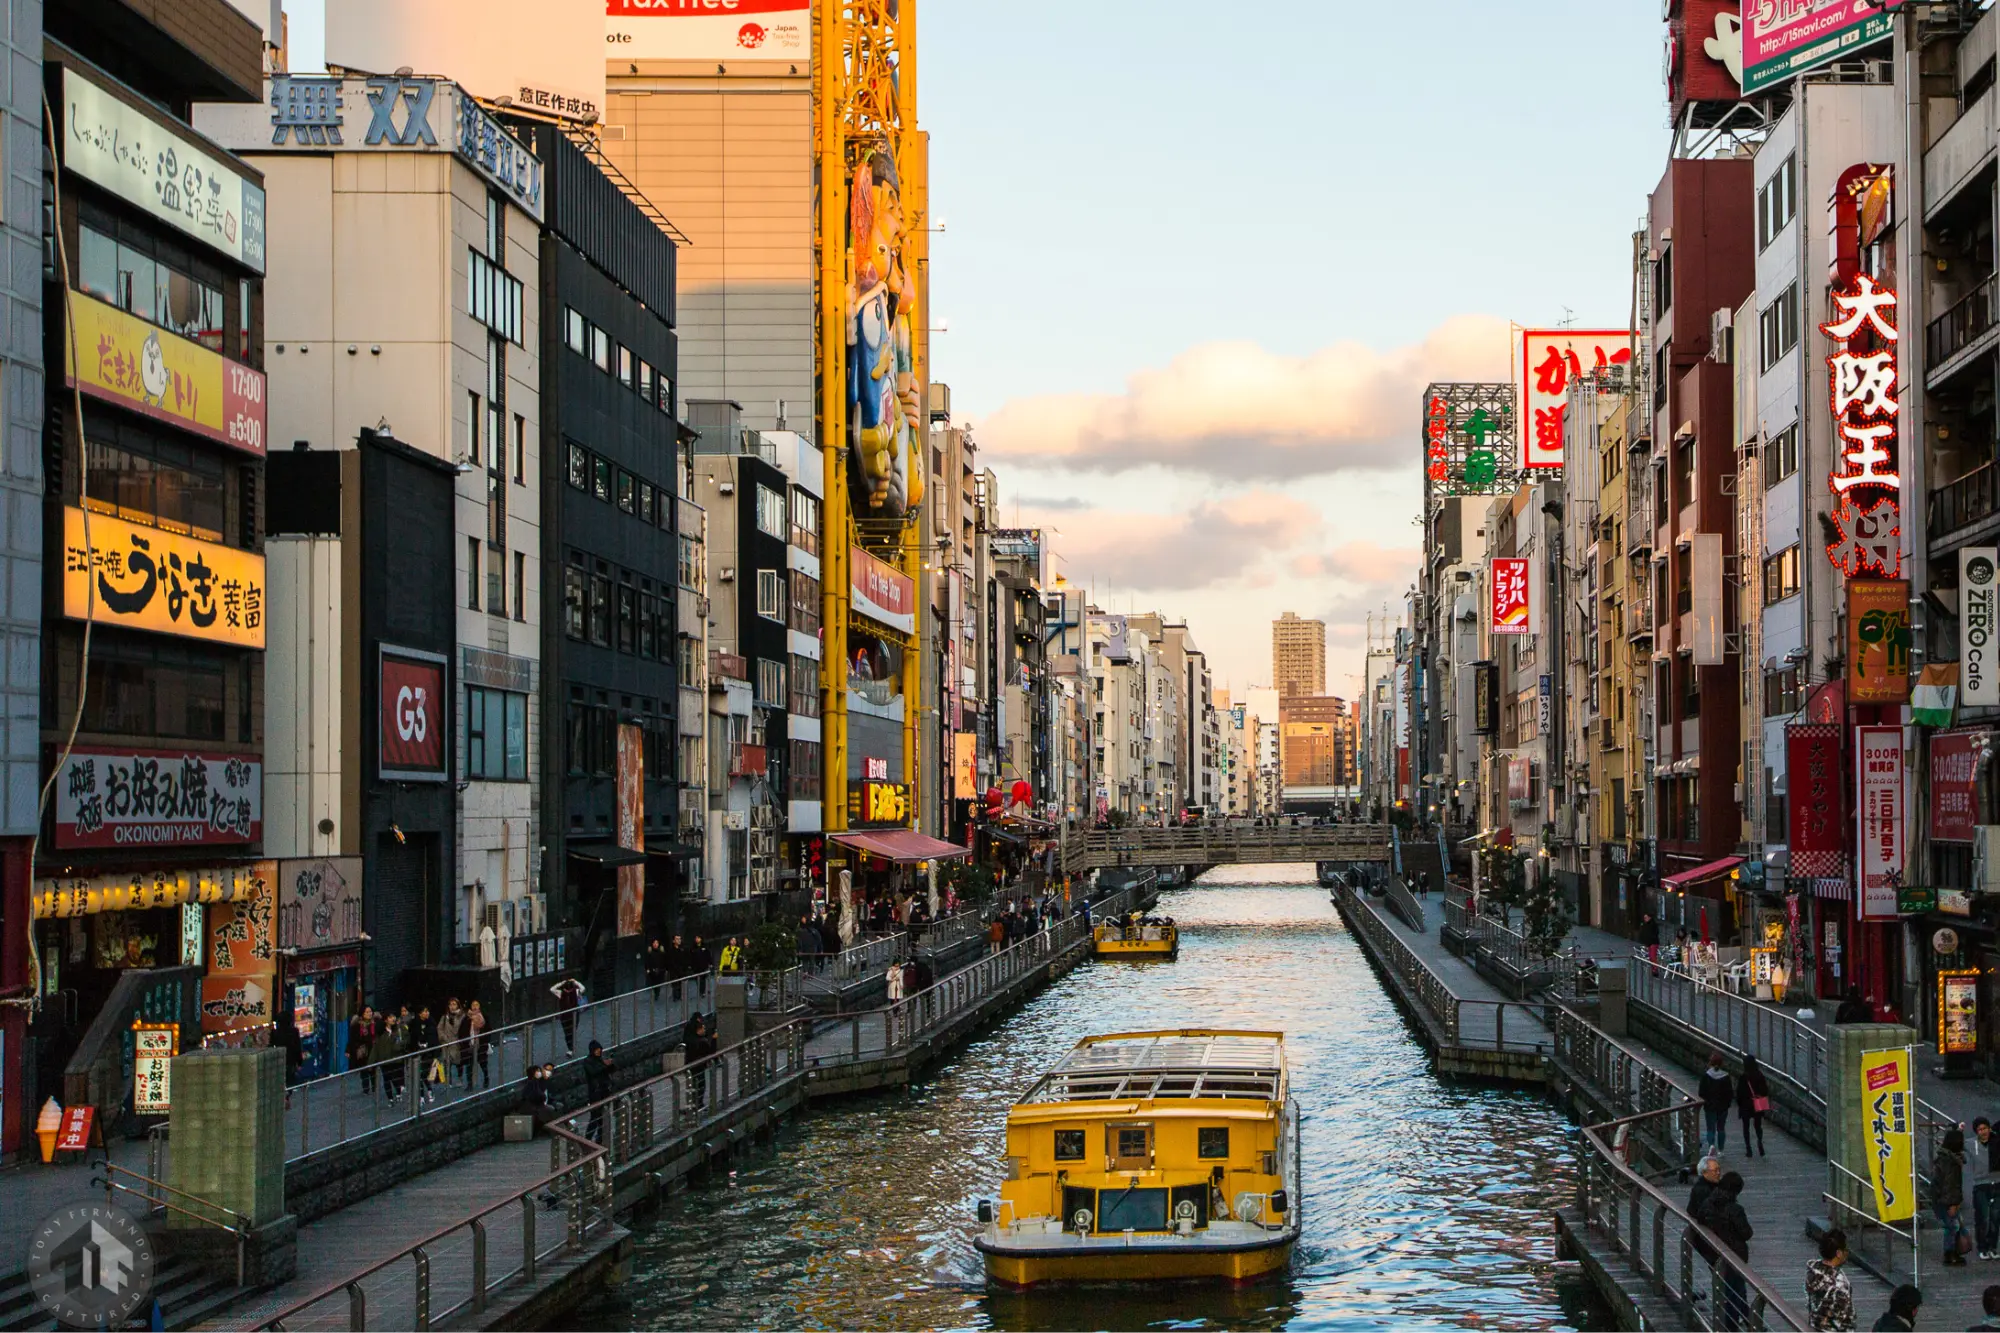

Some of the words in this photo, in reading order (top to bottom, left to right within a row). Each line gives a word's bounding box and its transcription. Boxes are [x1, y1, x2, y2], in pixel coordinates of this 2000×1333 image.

[1759, 6, 1848, 55] http://15navi.com/
[519, 87, 596, 114] 意匠作成中
[155, 147, 223, 234] 温野菜
[97, 333, 142, 395] だまれ
[231, 366, 261, 404] 17:00
[1427, 396, 1449, 482] お好み焼
[1820, 272, 1900, 580] 大阪王将
[98, 534, 218, 628] うなぎ
[221, 579, 261, 630] 菱富
[1495, 569, 1509, 615] ドラッグ
[1509, 562, 1525, 604] ツルハ
[1967, 589, 1988, 647] ZERO
[396, 685, 427, 743] G3
[1540, 696, 1550, 733] いろりや
[69, 758, 96, 798] 本場
[1866, 749, 1898, 759] 300円
[105, 756, 208, 819] お好み焼
[209, 787, 252, 837] たこ焼
[1809, 741, 1828, 837] 大阪みやげ
[76, 795, 103, 835] 大阪
[114, 824, 203, 843] OKONOMIYAKI
[1880, 789, 1894, 862] 三日月百子
[250, 878, 273, 960] お好み焼
[203, 1000, 266, 1017] てっぱん焼
[149, 1058, 164, 1102] お好み焼
[66, 1107, 86, 1146] 営業中
[1892, 1092, 1906, 1133] 道頓堀
